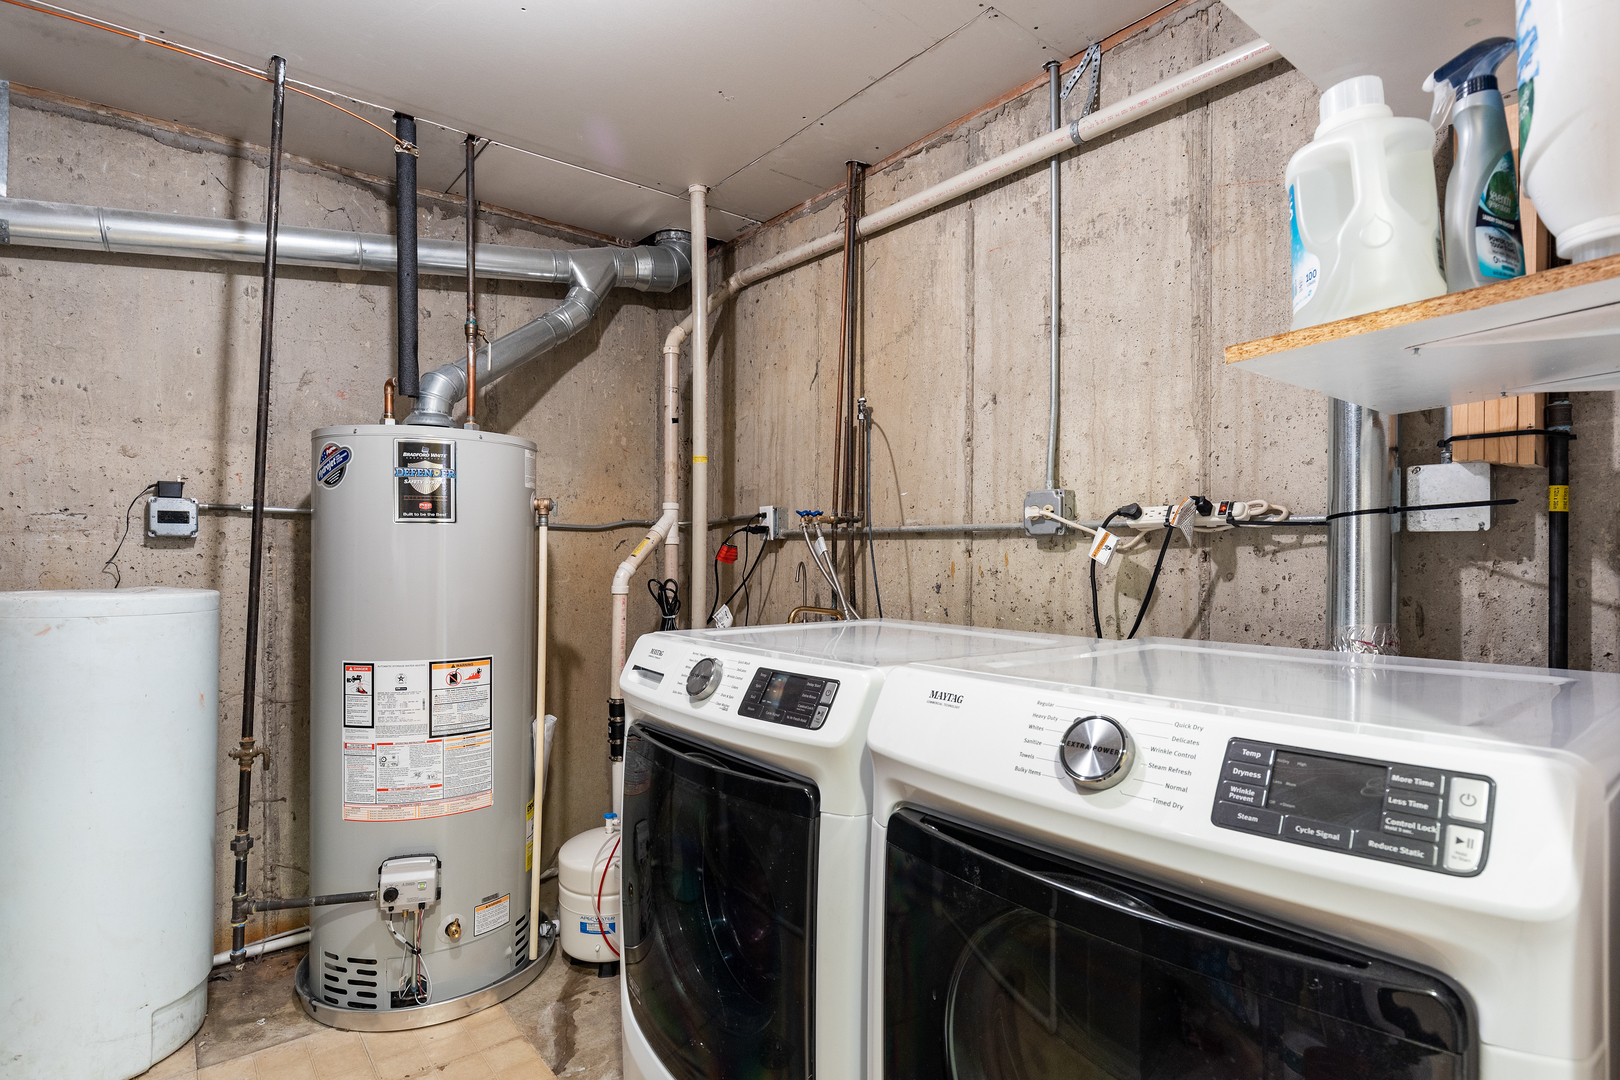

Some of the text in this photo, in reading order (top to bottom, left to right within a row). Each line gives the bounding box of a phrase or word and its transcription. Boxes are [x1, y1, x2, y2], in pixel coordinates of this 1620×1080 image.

[1306, 268, 1317, 283] 100
[395, 468, 455, 478] DEFENDER
[929, 690, 964, 704] MAYTAG
[1171, 736, 1200, 746] Delicates
[1066, 741, 1119, 756] EXTRA POWER
[1150, 746, 1196, 760] Wrinkle Control
[1242, 748, 1262, 758] Temp
[1014, 766, 1041, 776] Bulky Items
[1148, 762, 1192, 776] Steam Refresh
[1232, 768, 1261, 779] Dryness
[1391, 774, 1435, 788] More Time
[1165, 783, 1188, 793] Normal
[1230, 786, 1255, 796] Wrinkle
[1152, 797, 1184, 811] Timed Dry
[1229, 792, 1254, 803] Prevent
[1388, 797, 1429, 810] Less Time
[1237, 813, 1258, 822] Steam
[1385, 817, 1437, 834] Control Lock
[1295, 825, 1340, 841] Cycle Signal
[1368, 840, 1425, 859] Reduce Static
